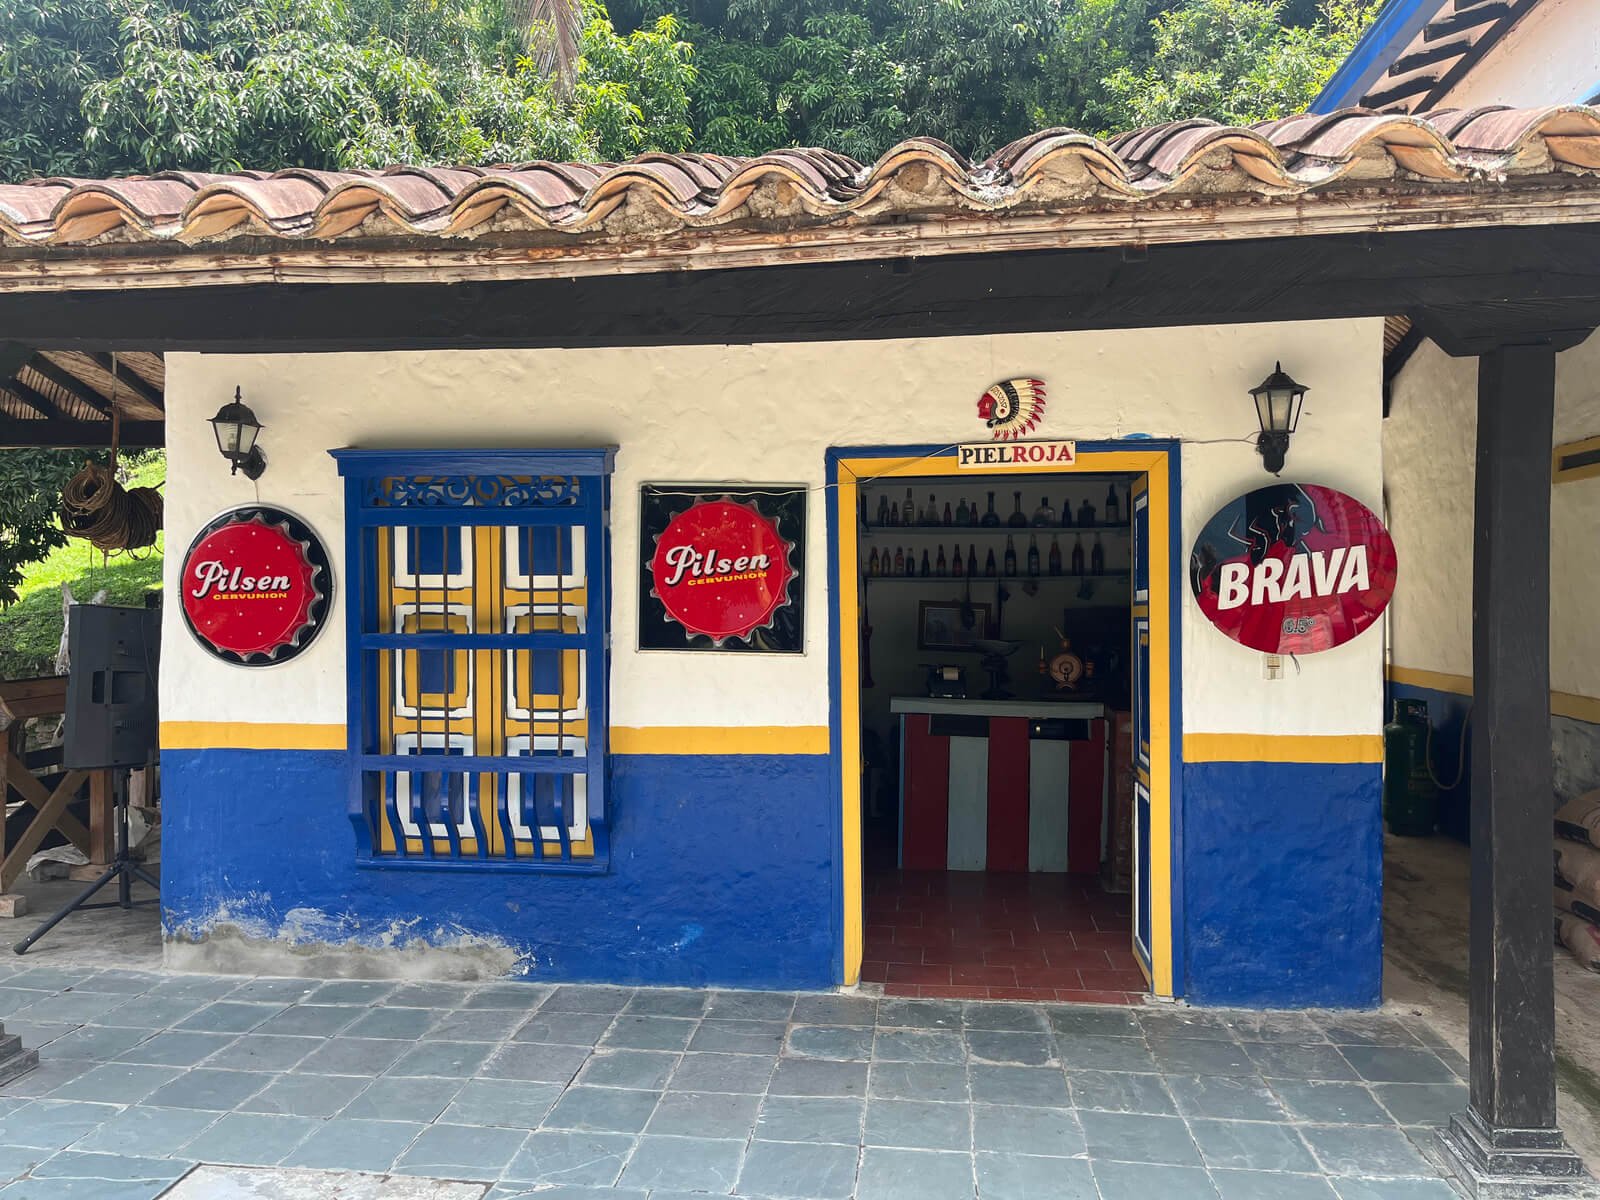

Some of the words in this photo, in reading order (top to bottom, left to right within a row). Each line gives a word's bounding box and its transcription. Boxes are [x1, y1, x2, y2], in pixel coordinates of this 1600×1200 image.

[960, 445, 1073, 465] PIELROJA
[191, 559, 292, 599] Pilsen
[664, 544, 771, 587] Pilsen
[687, 571, 768, 586] CERVUNION
[1217, 544, 1370, 610] BRAVA
[212, 592, 288, 601] CERVUNION
